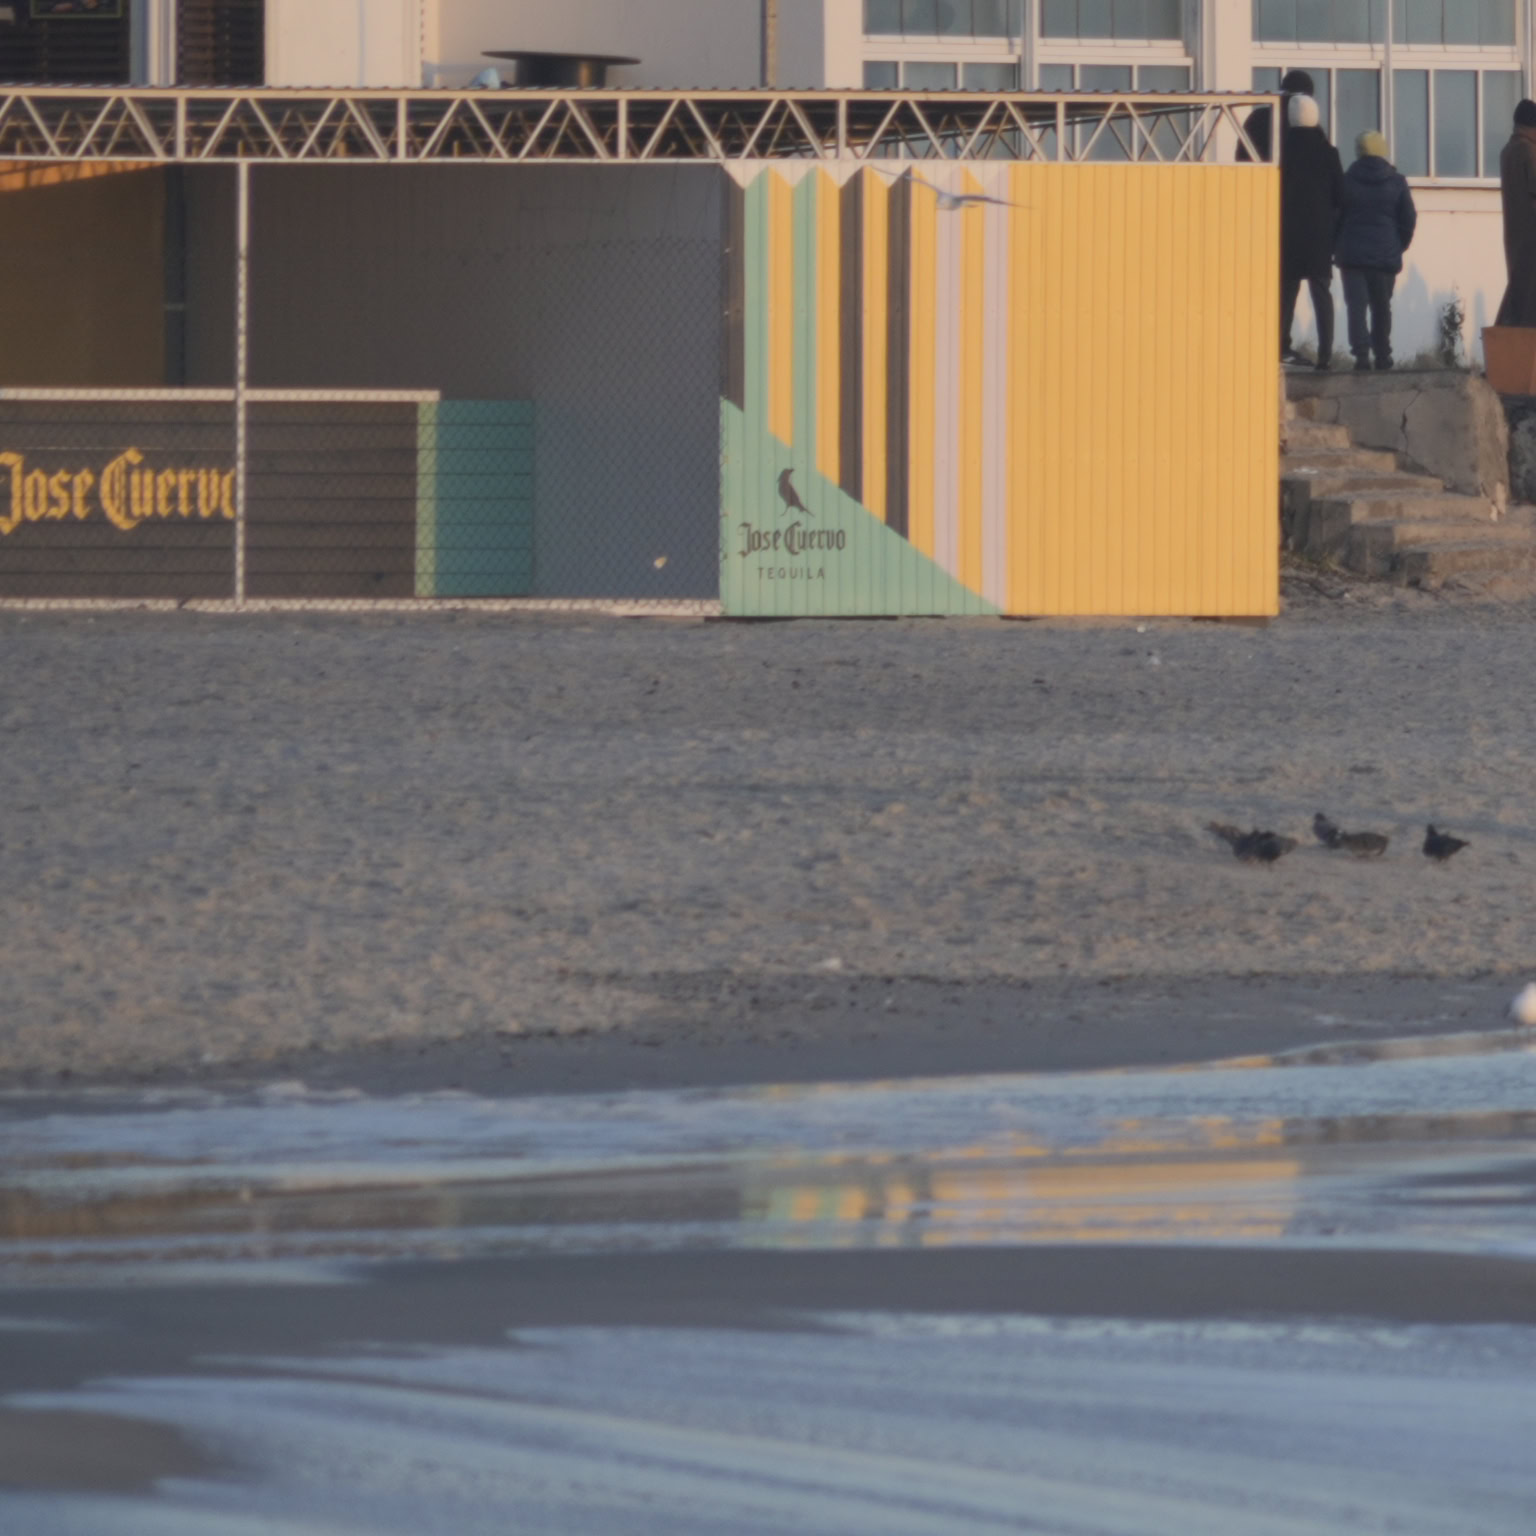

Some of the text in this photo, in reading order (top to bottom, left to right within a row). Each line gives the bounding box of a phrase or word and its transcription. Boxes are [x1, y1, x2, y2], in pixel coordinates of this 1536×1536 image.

[0, 451, 95, 536] Jose
[737, 520, 846, 559] Jose Cuervo
[758, 566, 826, 580] TEQUILA
